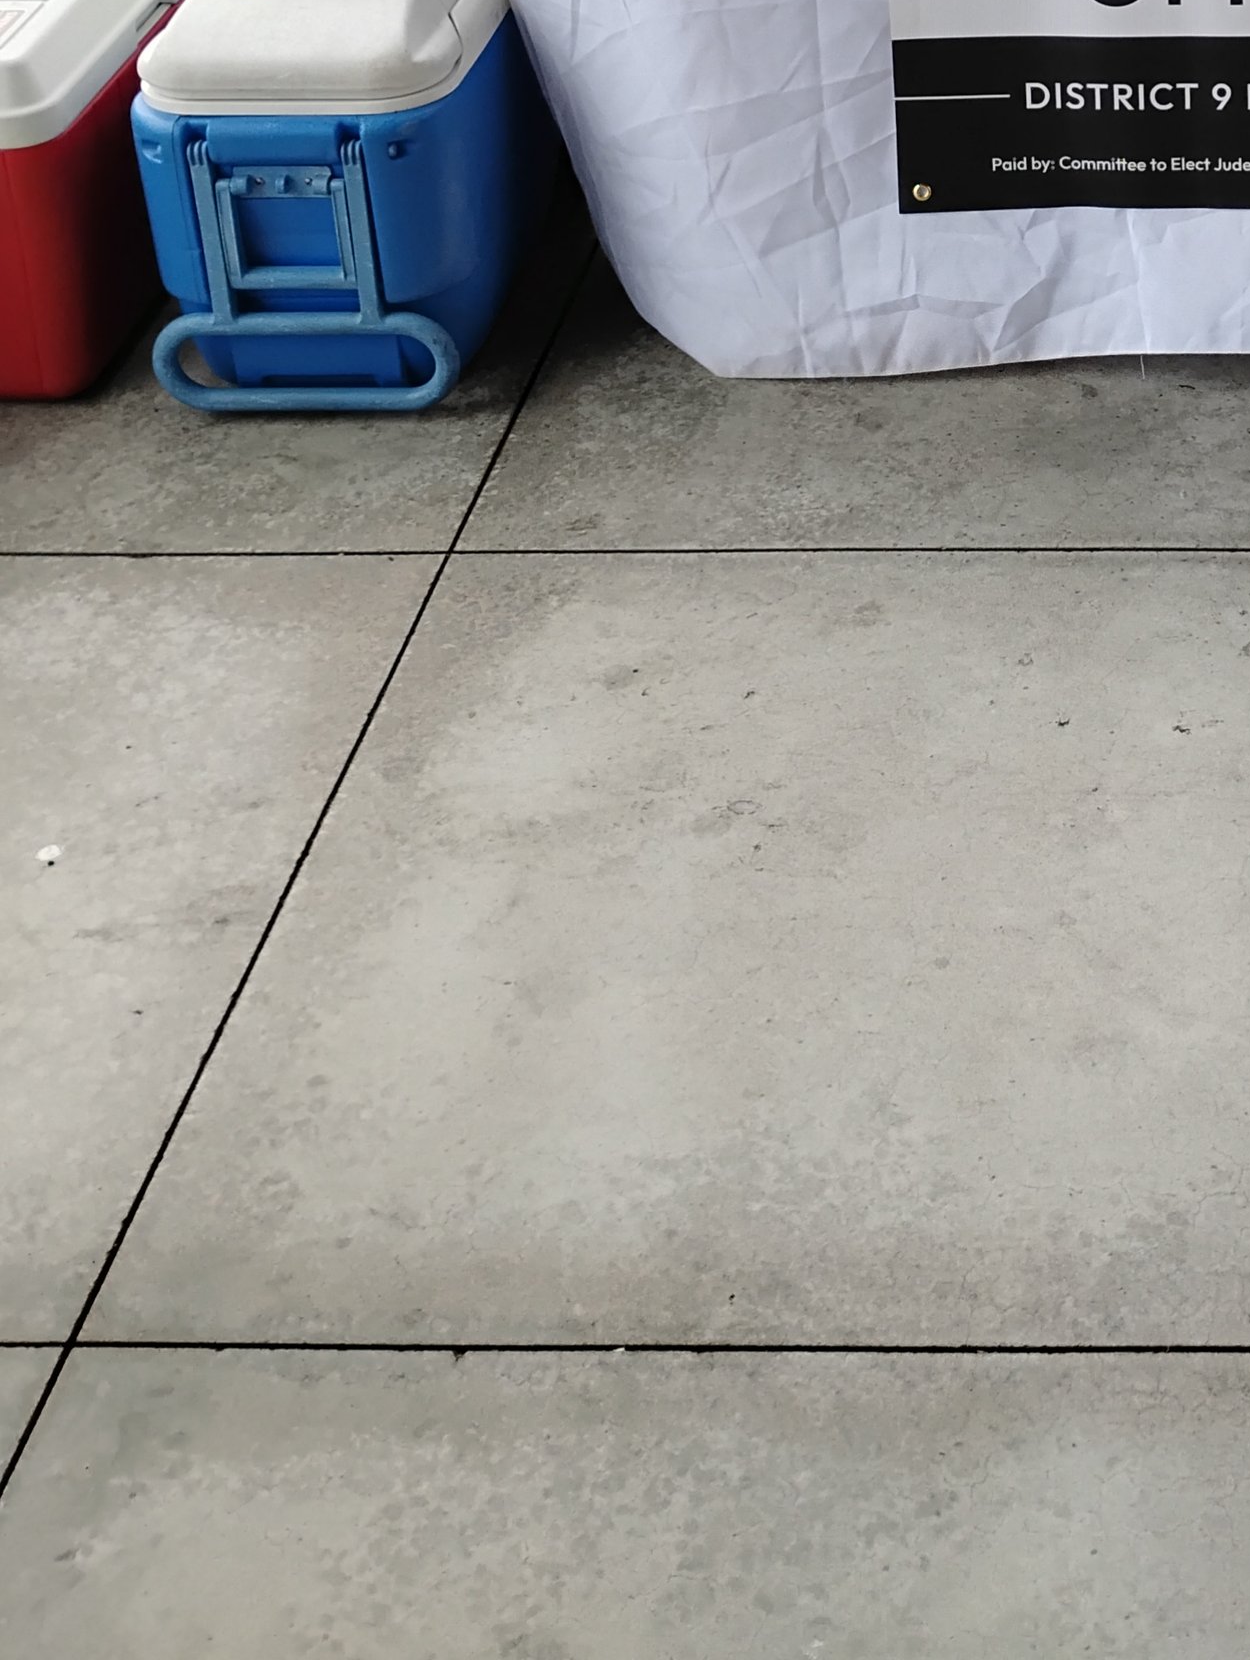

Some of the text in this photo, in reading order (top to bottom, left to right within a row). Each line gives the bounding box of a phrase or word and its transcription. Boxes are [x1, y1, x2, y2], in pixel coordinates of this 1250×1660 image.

[1025, 82, 1199, 111] DISTRICT
[1211, 83, 1232, 111] 9
[991, 157, 1027, 172] Paid
[1031, 157, 1056, 174] by:
[1059, 156, 1146, 172] Committee
[1150, 158, 1167, 172] to
[1171, 157, 1211, 172] Elect
